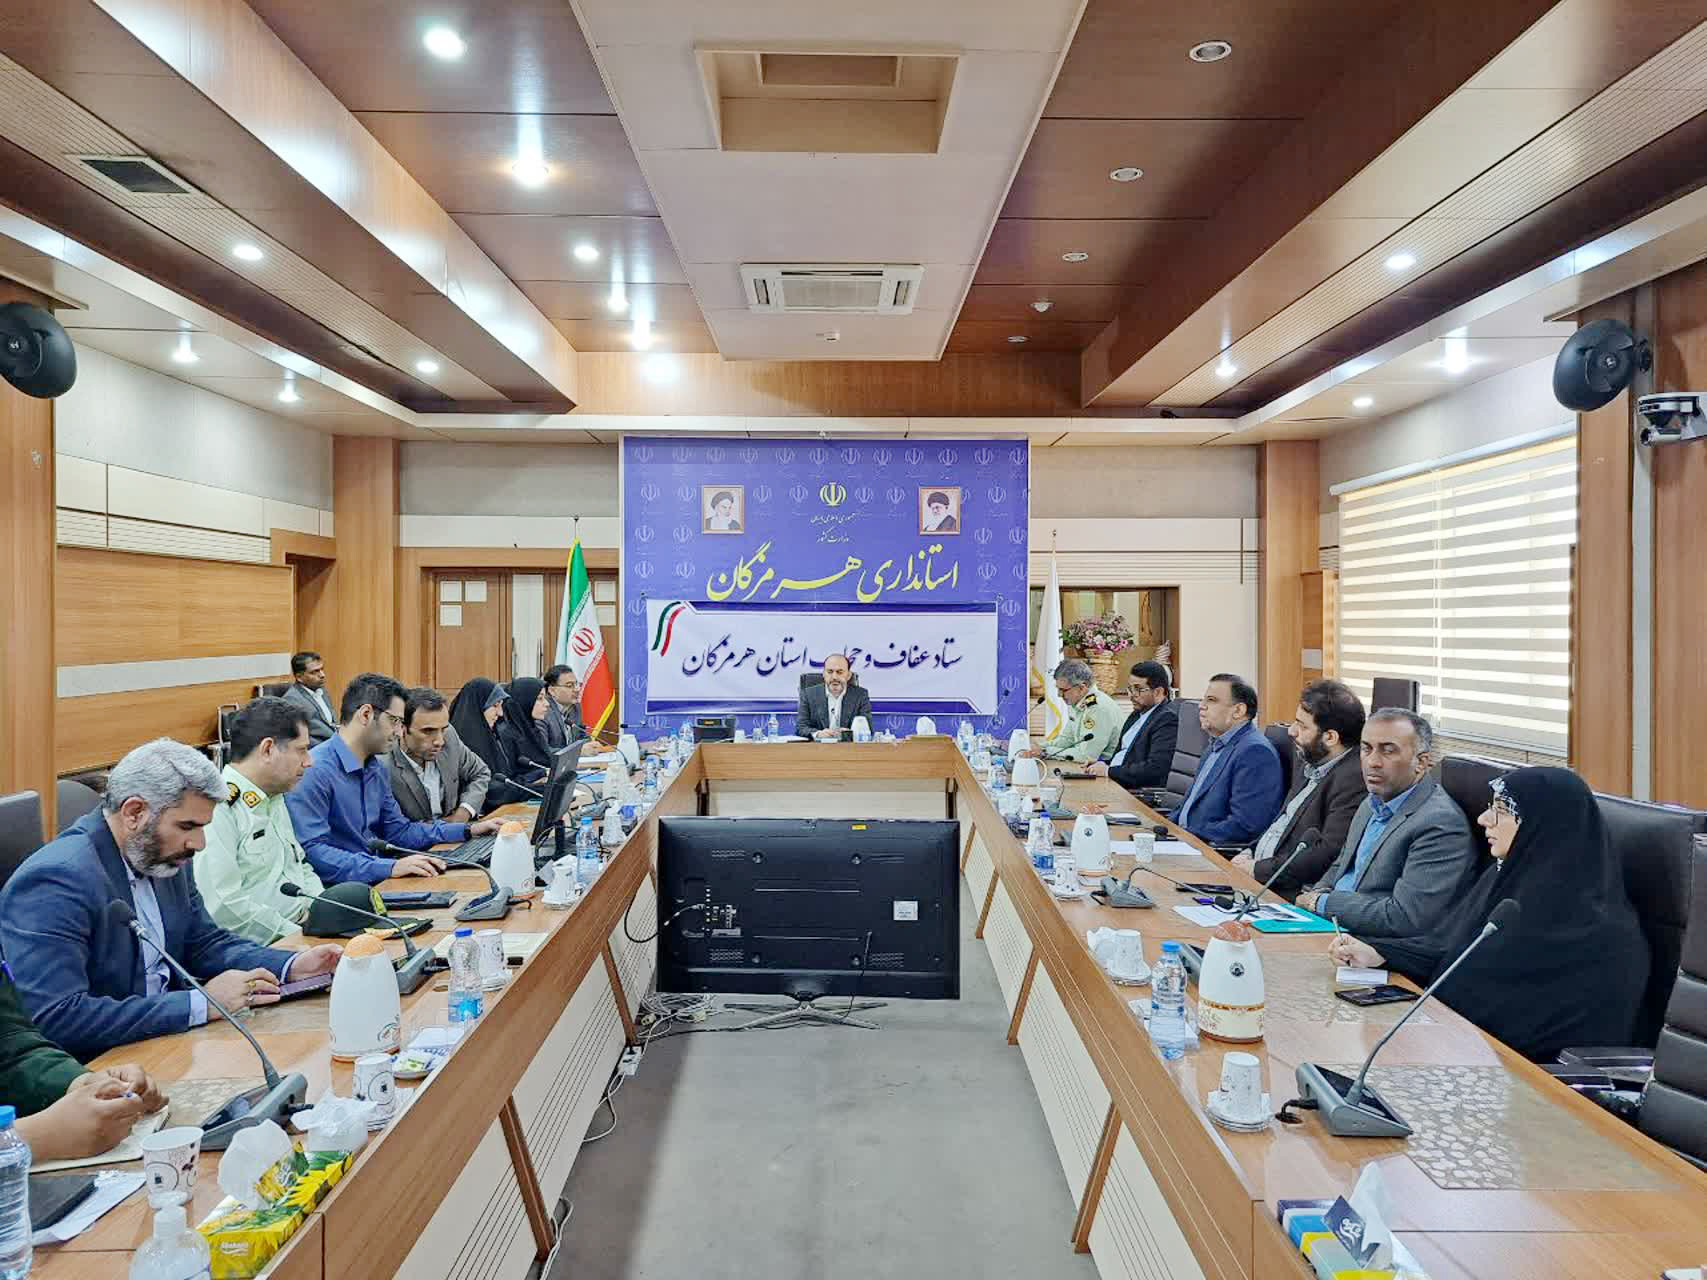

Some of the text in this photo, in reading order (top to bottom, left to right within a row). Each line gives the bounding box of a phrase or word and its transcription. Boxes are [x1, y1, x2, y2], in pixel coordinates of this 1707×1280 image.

[706, 540, 960, 603] استانداری هرمزگان
[682, 633, 756, 677] هرمزگان
[756, 636, 807, 677] استان
[863, 653, 872, 669] و
[873, 642, 930, 669] عفاف
[932, 636, 963, 669] ستاد
